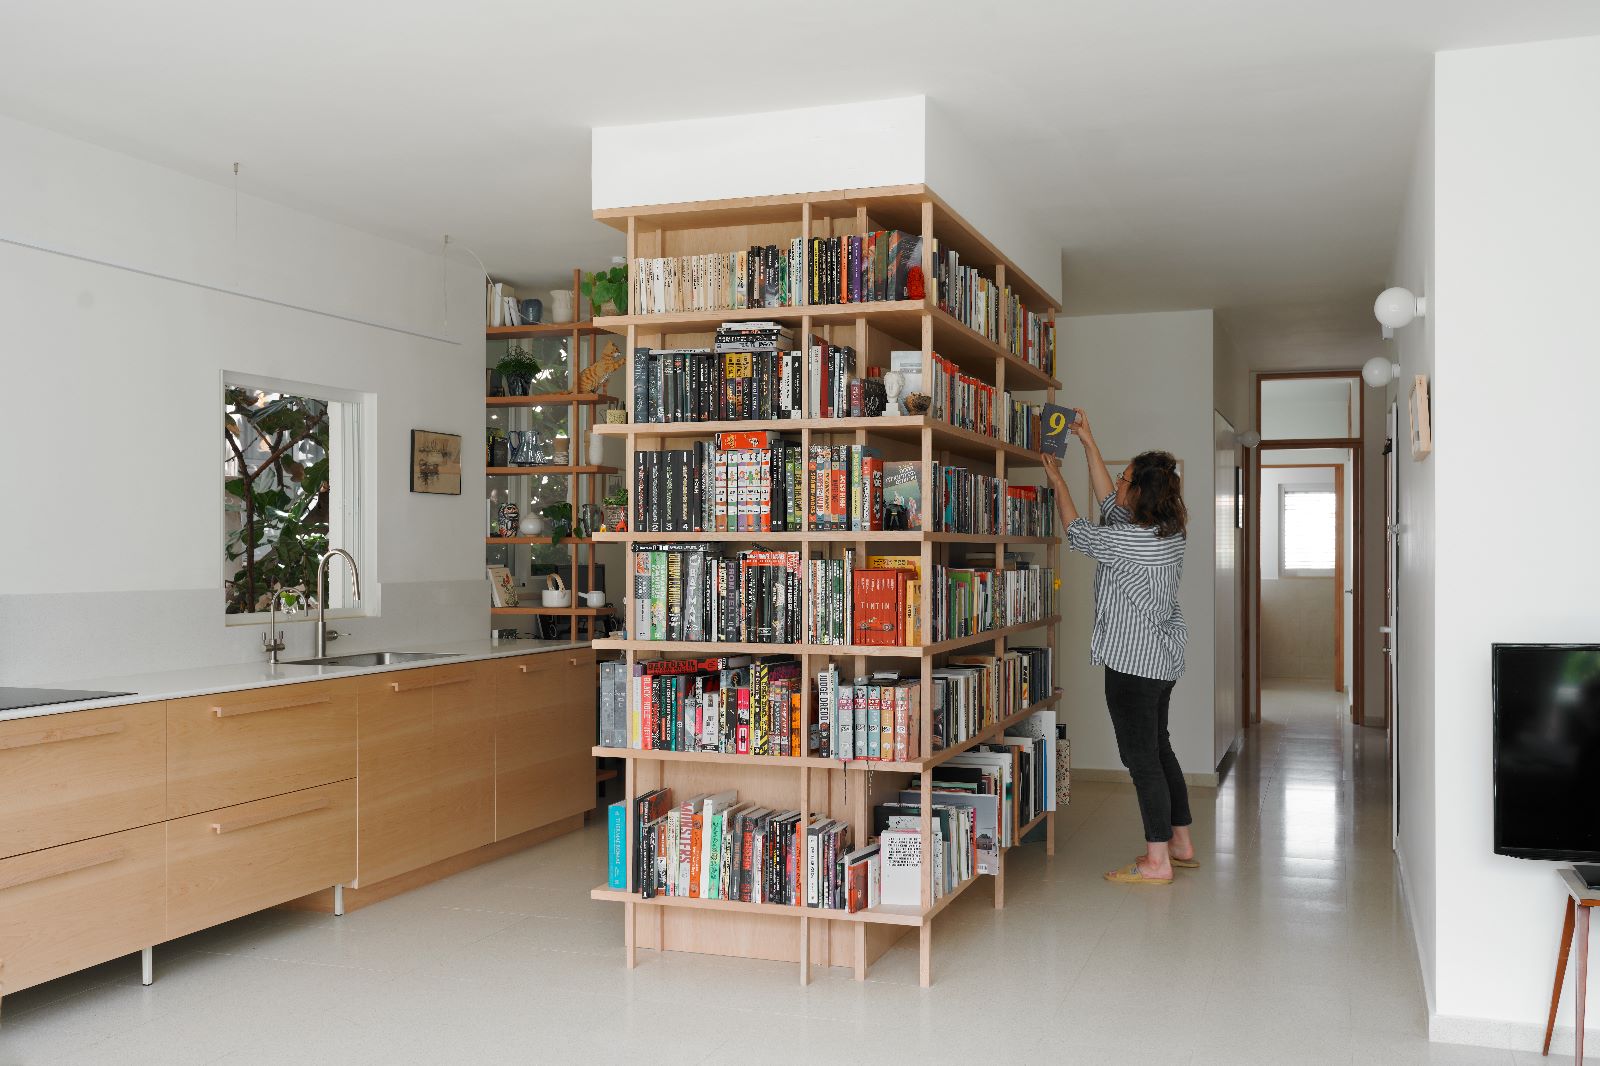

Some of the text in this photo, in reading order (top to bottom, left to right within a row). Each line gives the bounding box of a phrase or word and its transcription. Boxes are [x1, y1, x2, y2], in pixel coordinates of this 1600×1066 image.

[1046, 412, 1066, 436] 9
[669, 554, 680, 606] GOTHAM CENTRAL
[820, 674, 828, 721] JUDGE DREDD
[680, 801, 694, 864] MONSTERS
